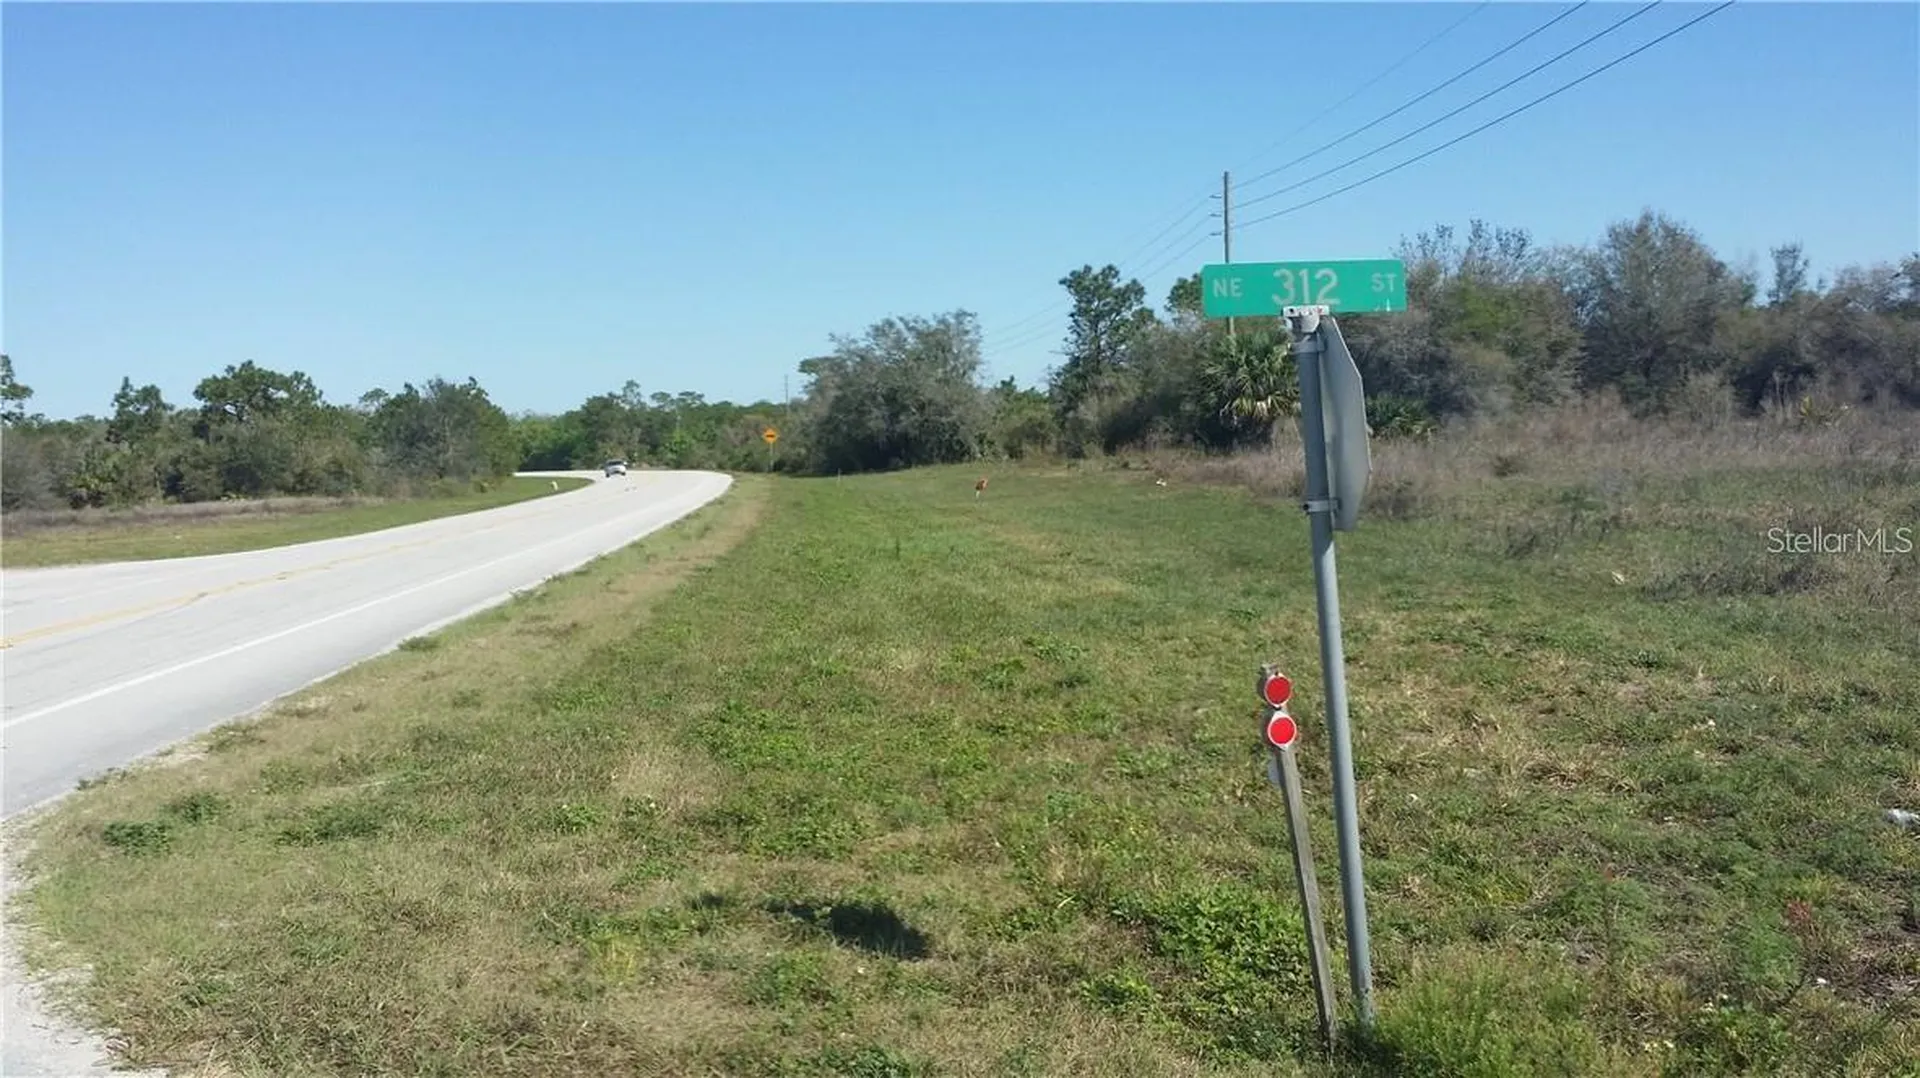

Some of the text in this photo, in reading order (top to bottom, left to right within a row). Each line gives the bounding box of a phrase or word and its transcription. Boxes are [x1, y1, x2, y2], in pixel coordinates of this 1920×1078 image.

[1213, 267, 1397, 305] NE 312 ST
